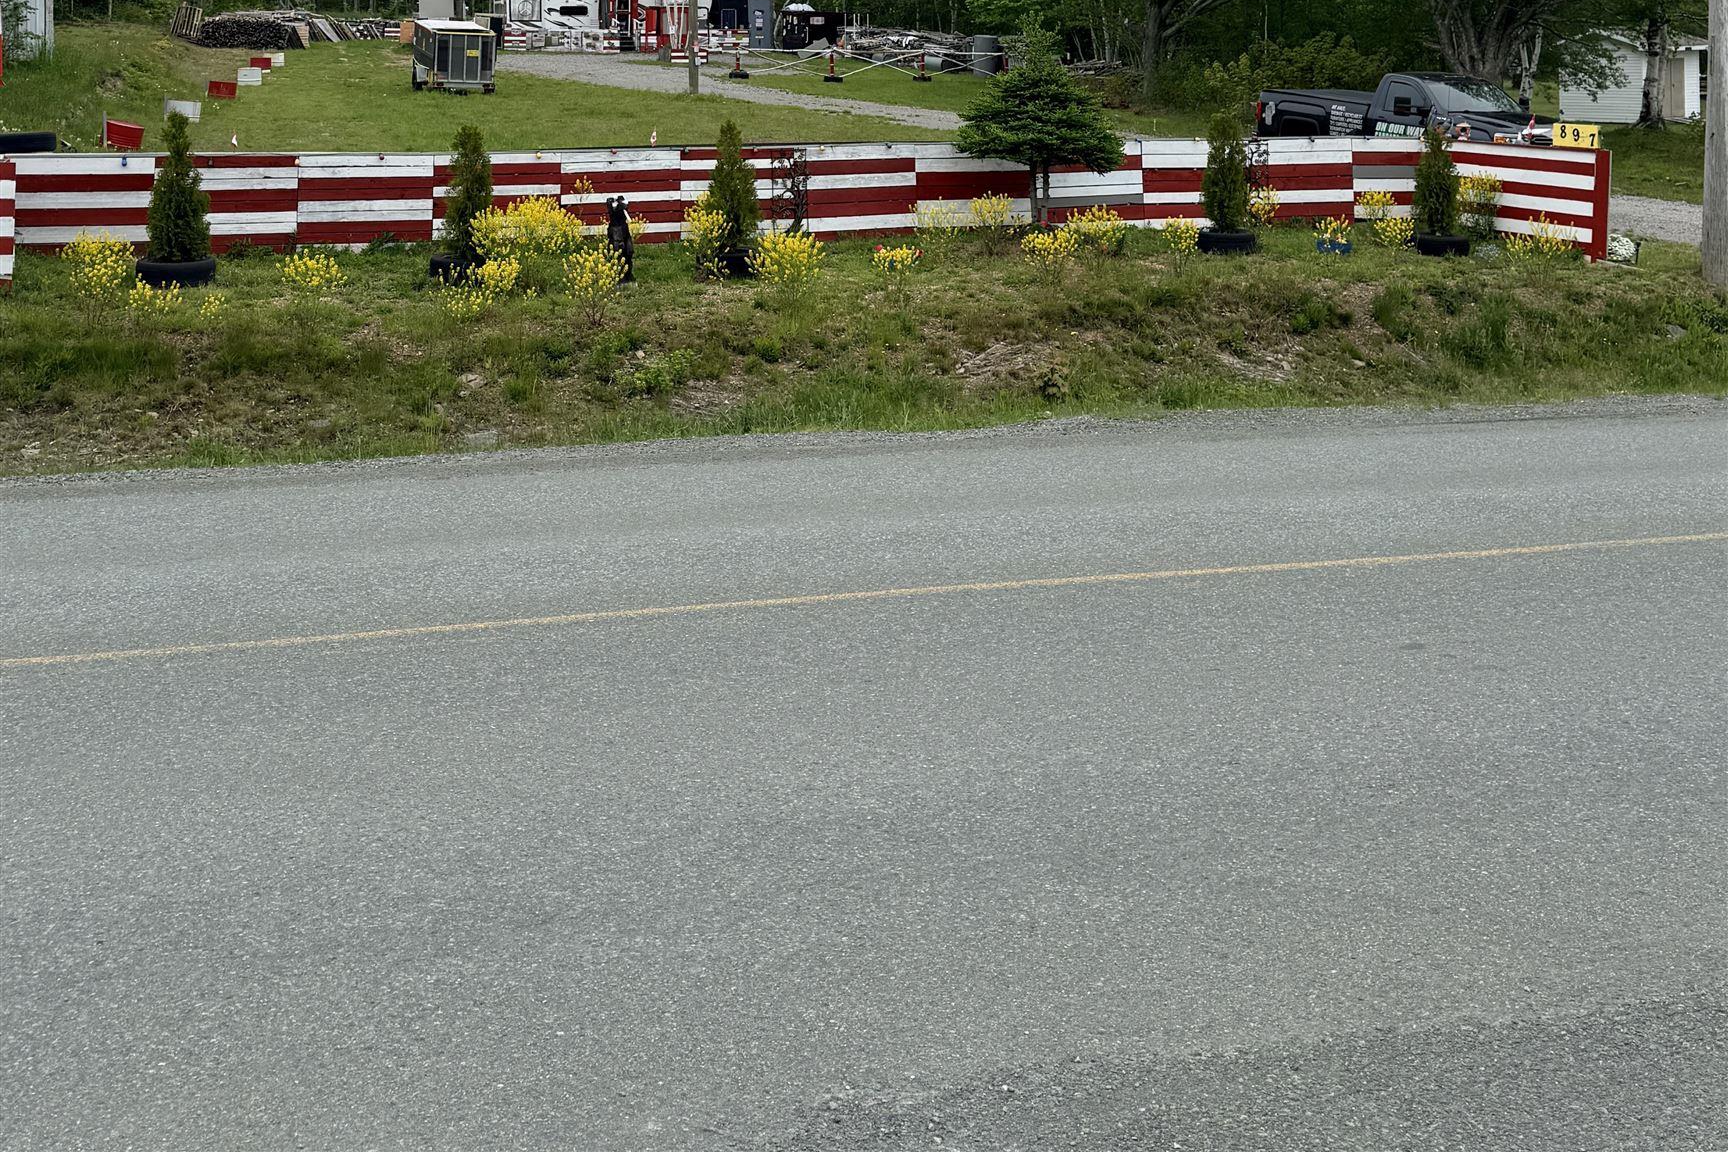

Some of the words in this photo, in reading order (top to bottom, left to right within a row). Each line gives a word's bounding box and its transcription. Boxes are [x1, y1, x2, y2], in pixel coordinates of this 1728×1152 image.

[1375, 121, 1388, 132] ON
[1388, 123, 1406, 135] OUR
[1406, 125, 1426, 137] WAY
